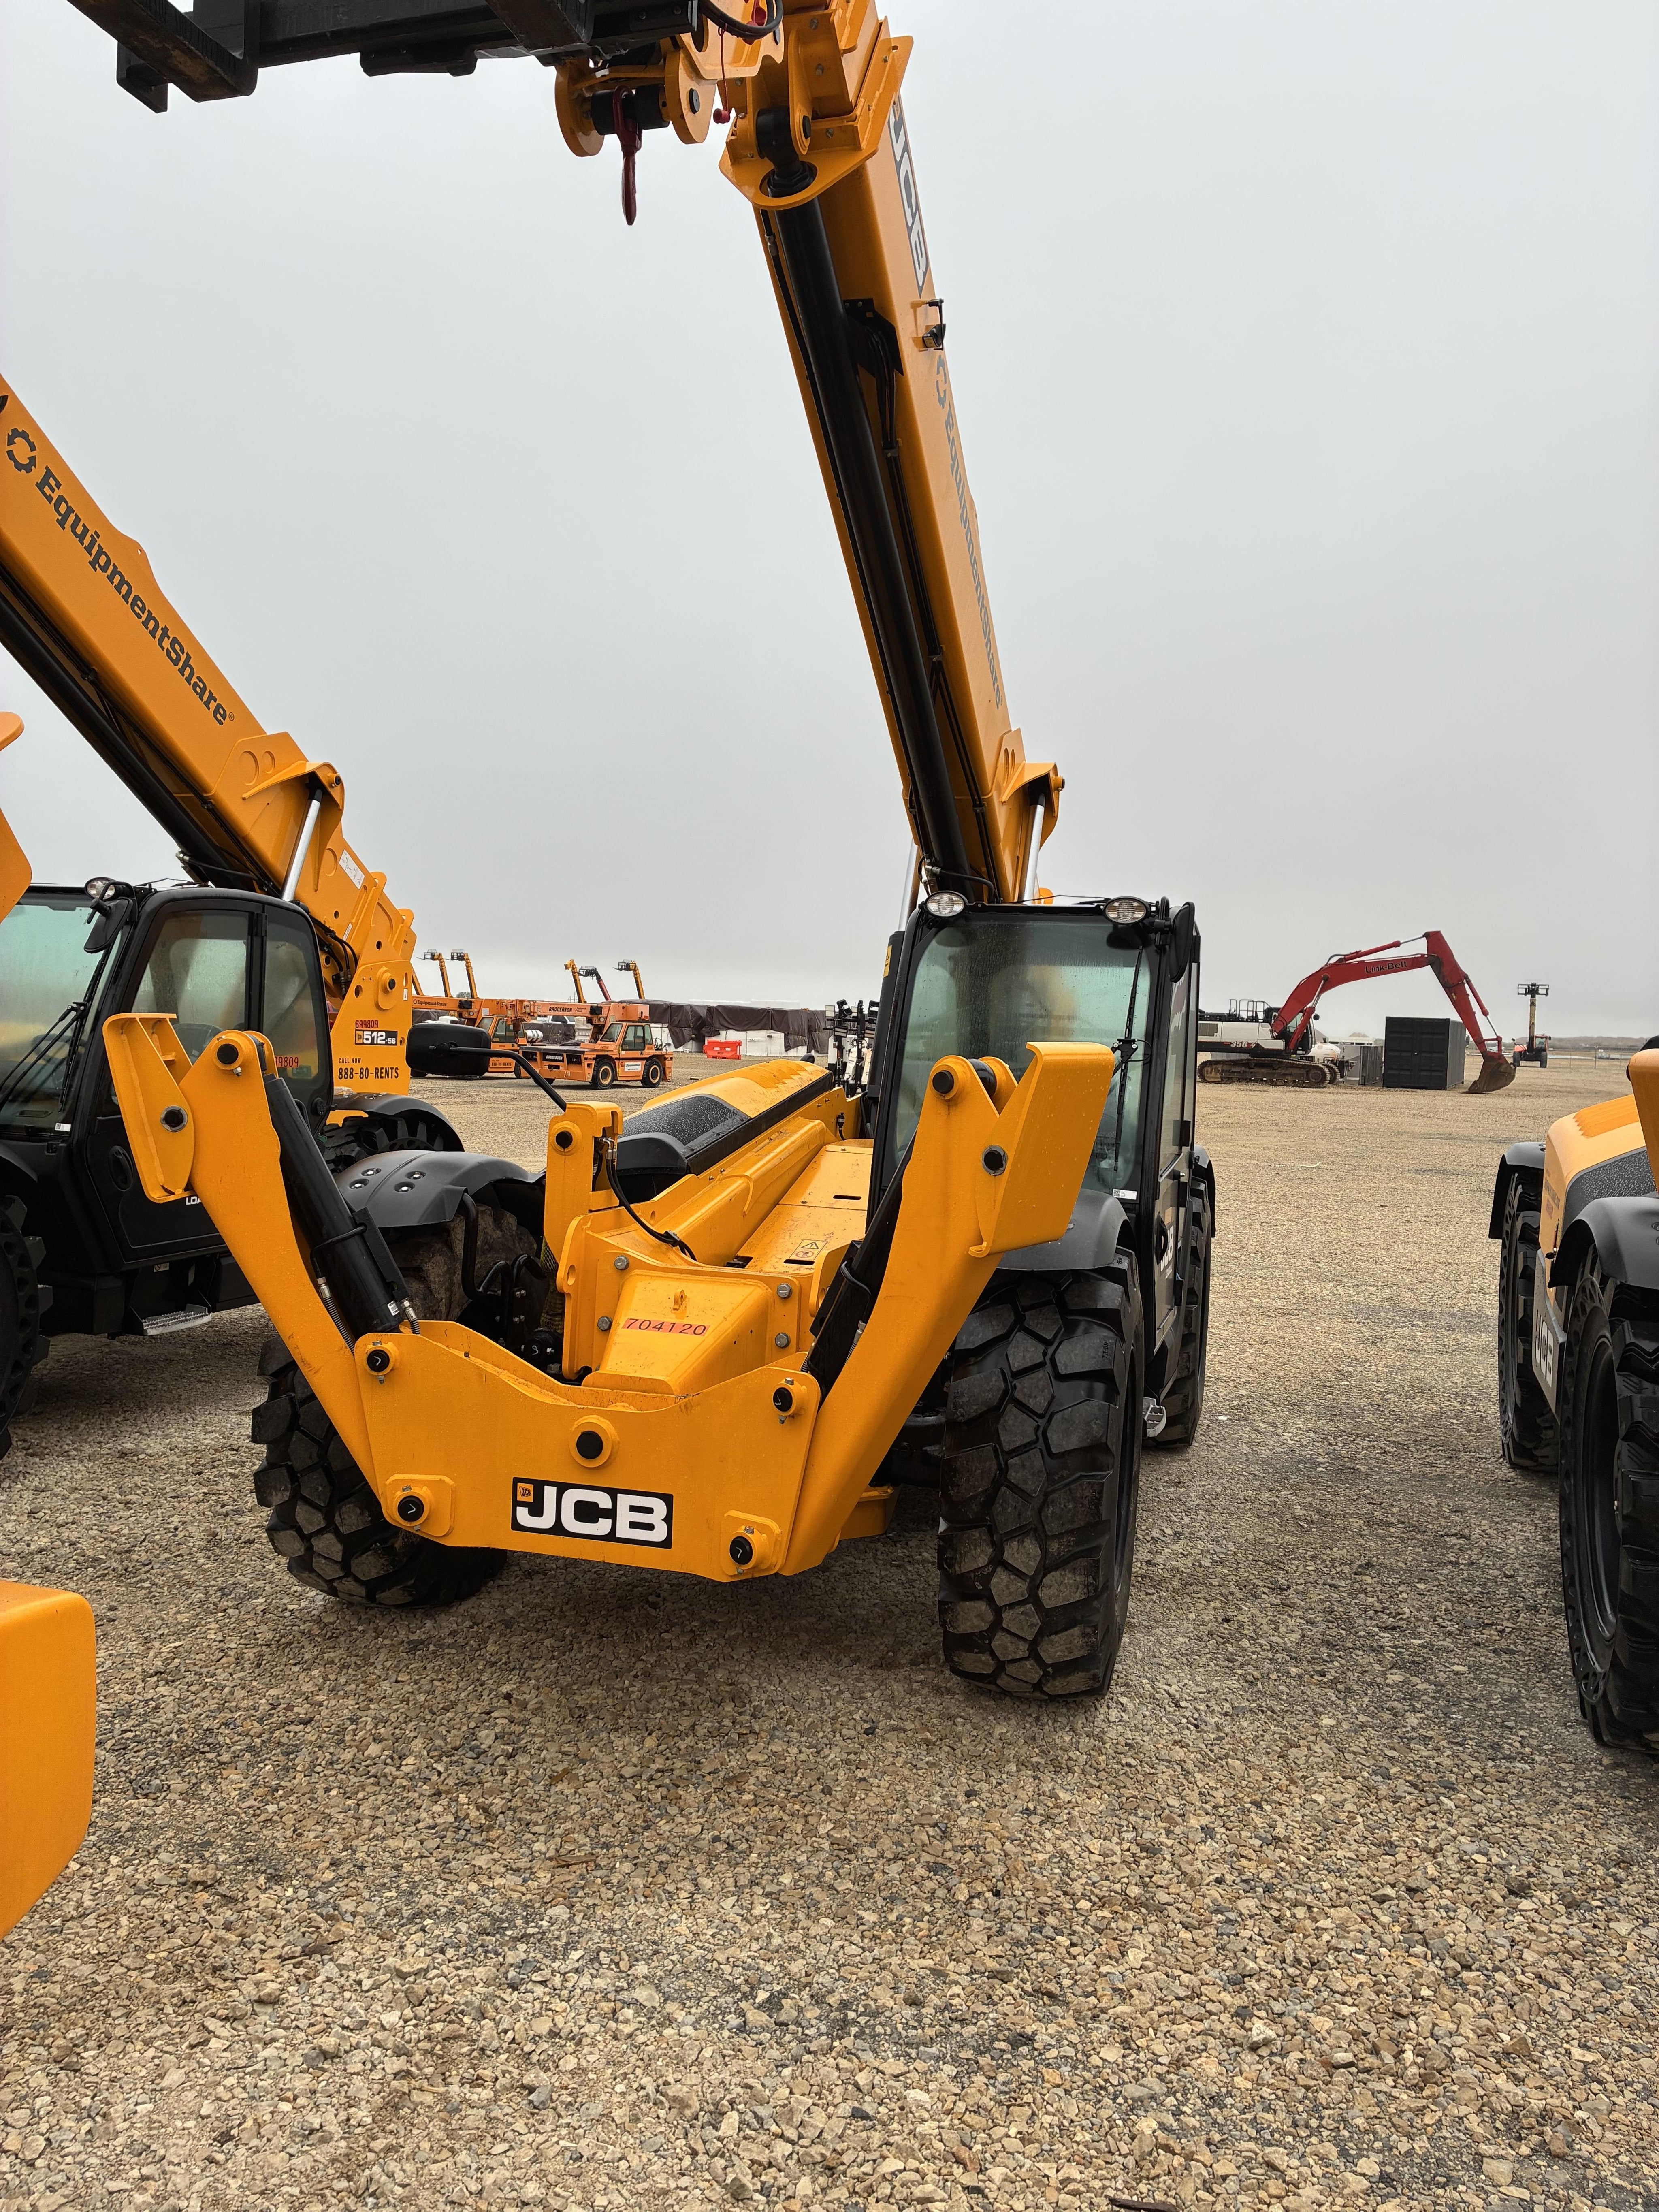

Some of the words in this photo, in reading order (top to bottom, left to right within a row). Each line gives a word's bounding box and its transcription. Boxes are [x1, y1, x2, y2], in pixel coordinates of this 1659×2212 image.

[945, 400, 1000, 710] EquipmentShare
[35, 465, 227, 726] EquipmentShare
[1365, 961, 1407, 973] Link-Belt
[355, 1020, 378, 1028] 699809
[338, 1067, 399, 1080] 888-80-RENTS
[626, 1318, 706, 1335] 704120
[516, 1486, 668, 1542] JCB
